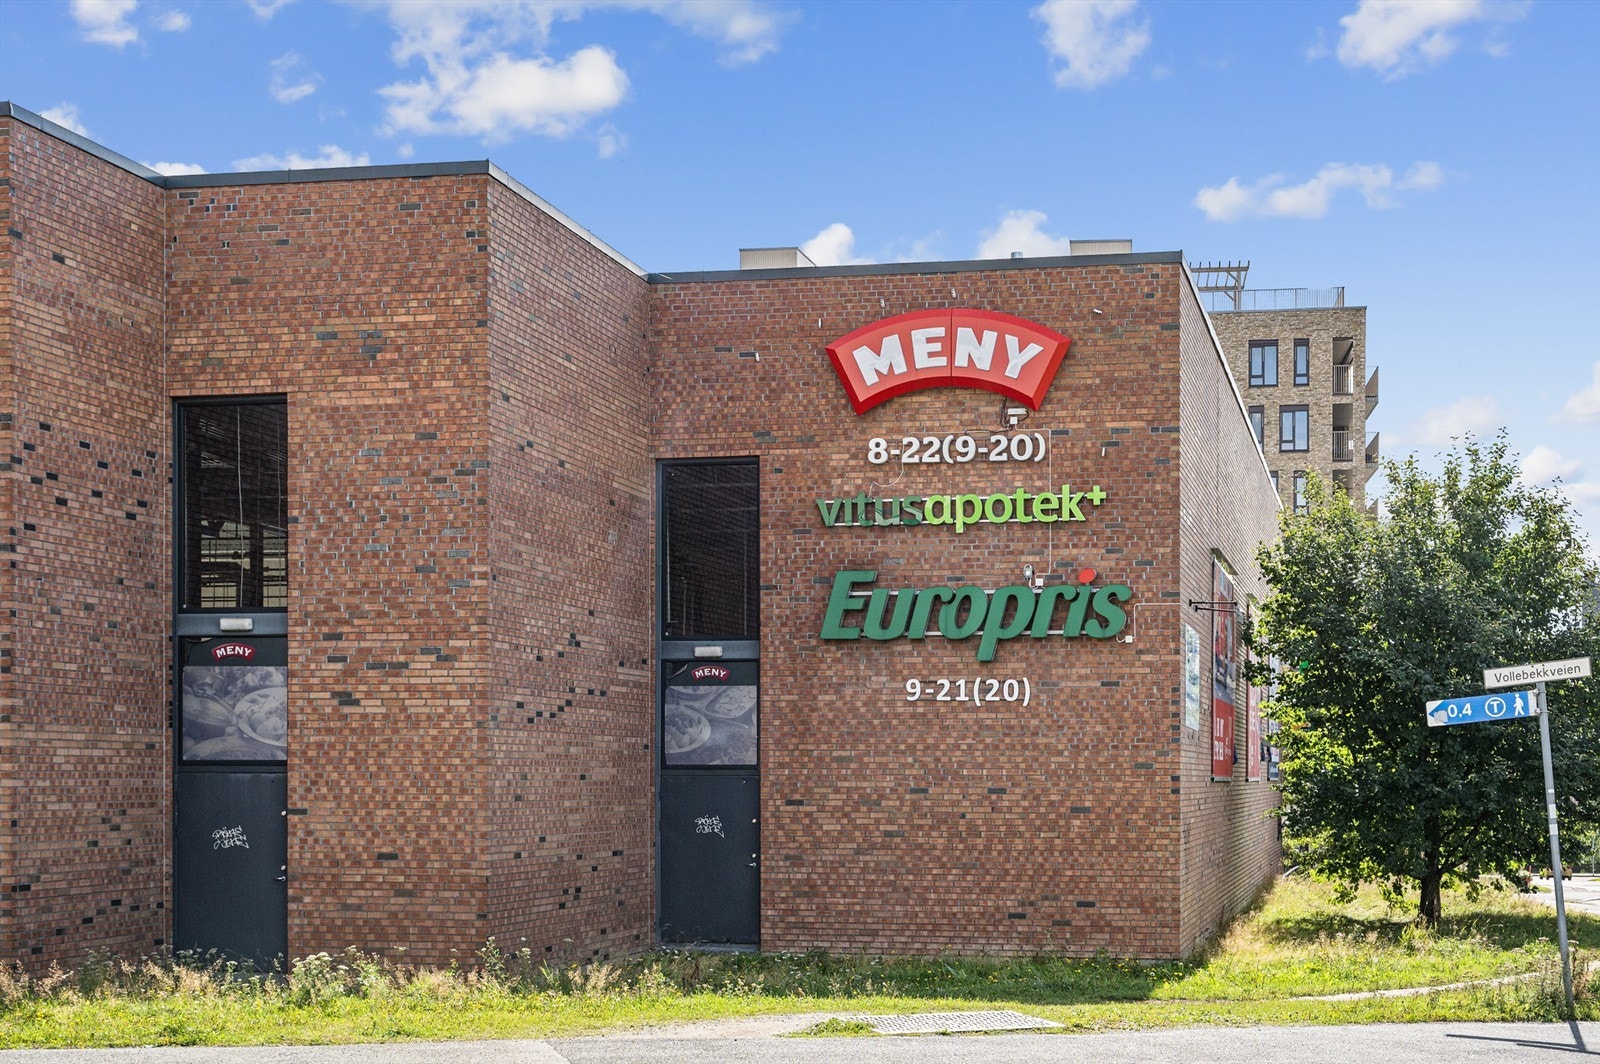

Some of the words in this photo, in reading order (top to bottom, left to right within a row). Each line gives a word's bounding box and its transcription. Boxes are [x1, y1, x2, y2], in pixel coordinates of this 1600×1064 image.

[852, 327, 1044, 387] MENY
[820, 567, 1132, 662] Europris
[216, 646, 252, 657] MENY
[695, 668, 726, 678] MENY
[1494, 664, 1581, 683] Vollebekkveien
[905, 677, 1031, 707] 9-21(20)
[1447, 702, 1473, 719] 0,4
